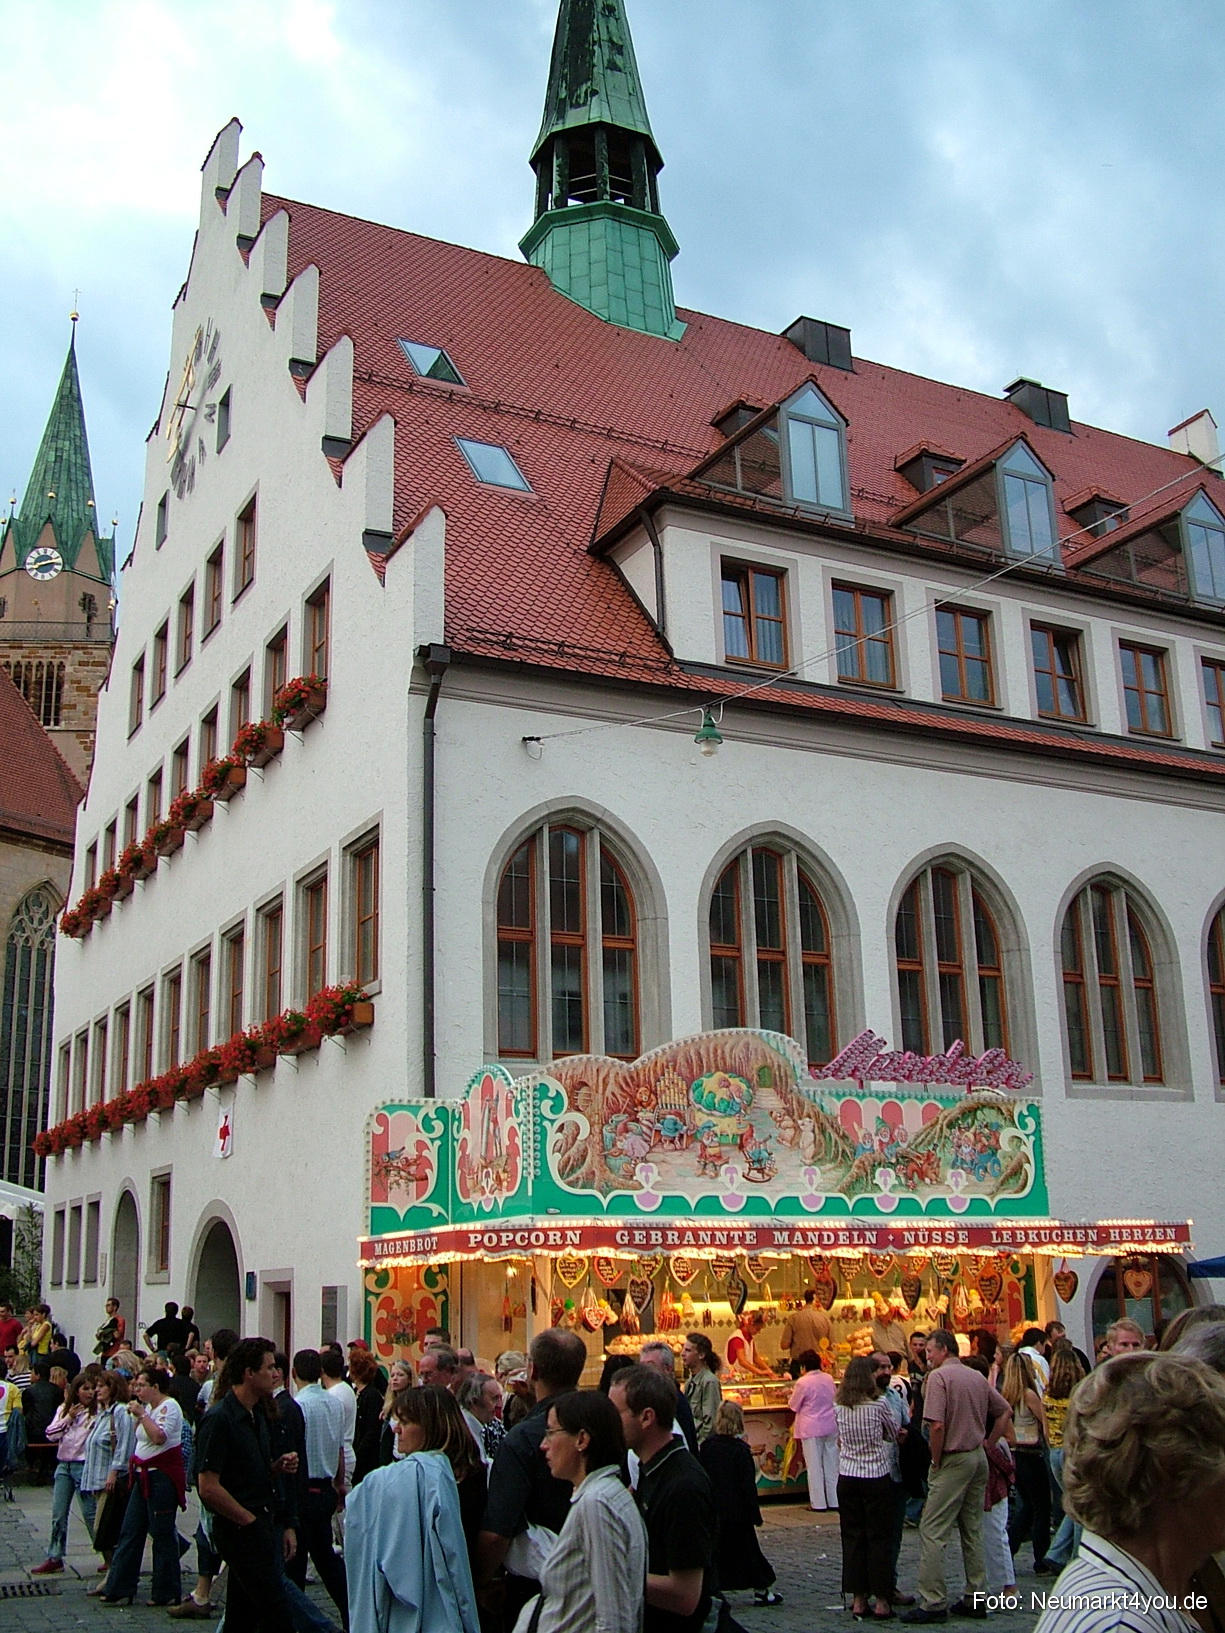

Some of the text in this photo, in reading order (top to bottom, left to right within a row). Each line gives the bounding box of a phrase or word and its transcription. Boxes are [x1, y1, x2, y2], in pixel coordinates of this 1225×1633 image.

[468, 1230, 582, 1248] POPCORN
[615, 1230, 757, 1245] GEBRANNTE
[772, 1230, 878, 1245] MANDELN
[903, 1228, 969, 1245] NÜSSE
[374, 1236, 438, 1256] MAGENBROT
